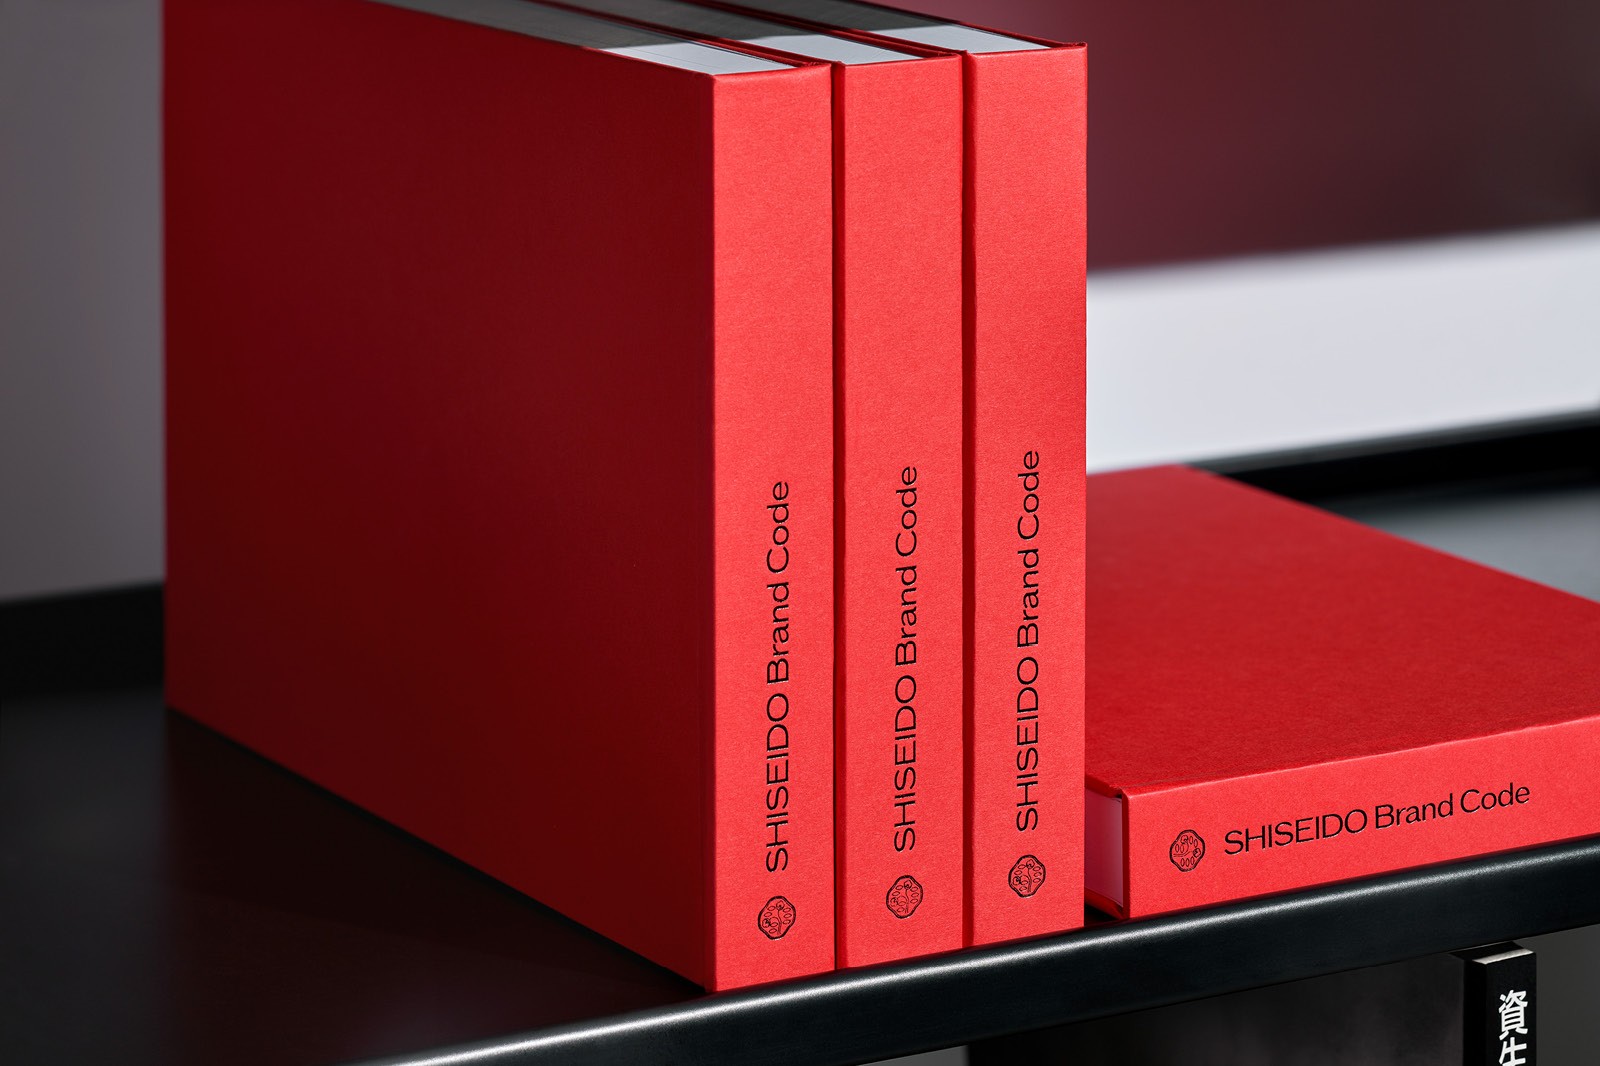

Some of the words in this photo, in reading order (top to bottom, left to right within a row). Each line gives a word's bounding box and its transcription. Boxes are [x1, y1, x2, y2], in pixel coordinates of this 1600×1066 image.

[766, 481, 790, 574] Code
[895, 466, 917, 557] Code
[1017, 450, 1040, 540] Code
[766, 581, 790, 684] Brand
[895, 565, 917, 666] Brand
[1017, 548, 1039, 648] Brand
[766, 693, 790, 873] SHISEIDO
[894, 674, 917, 853] SHISEIDO
[1016, 656, 1039, 832] SHISEIDO
[1224, 808, 1368, 855] SHISEIDO
[1375, 792, 1454, 830] Brand
[1460, 782, 1531, 813] Code
[1498, 989, 1528, 1066] 資生
